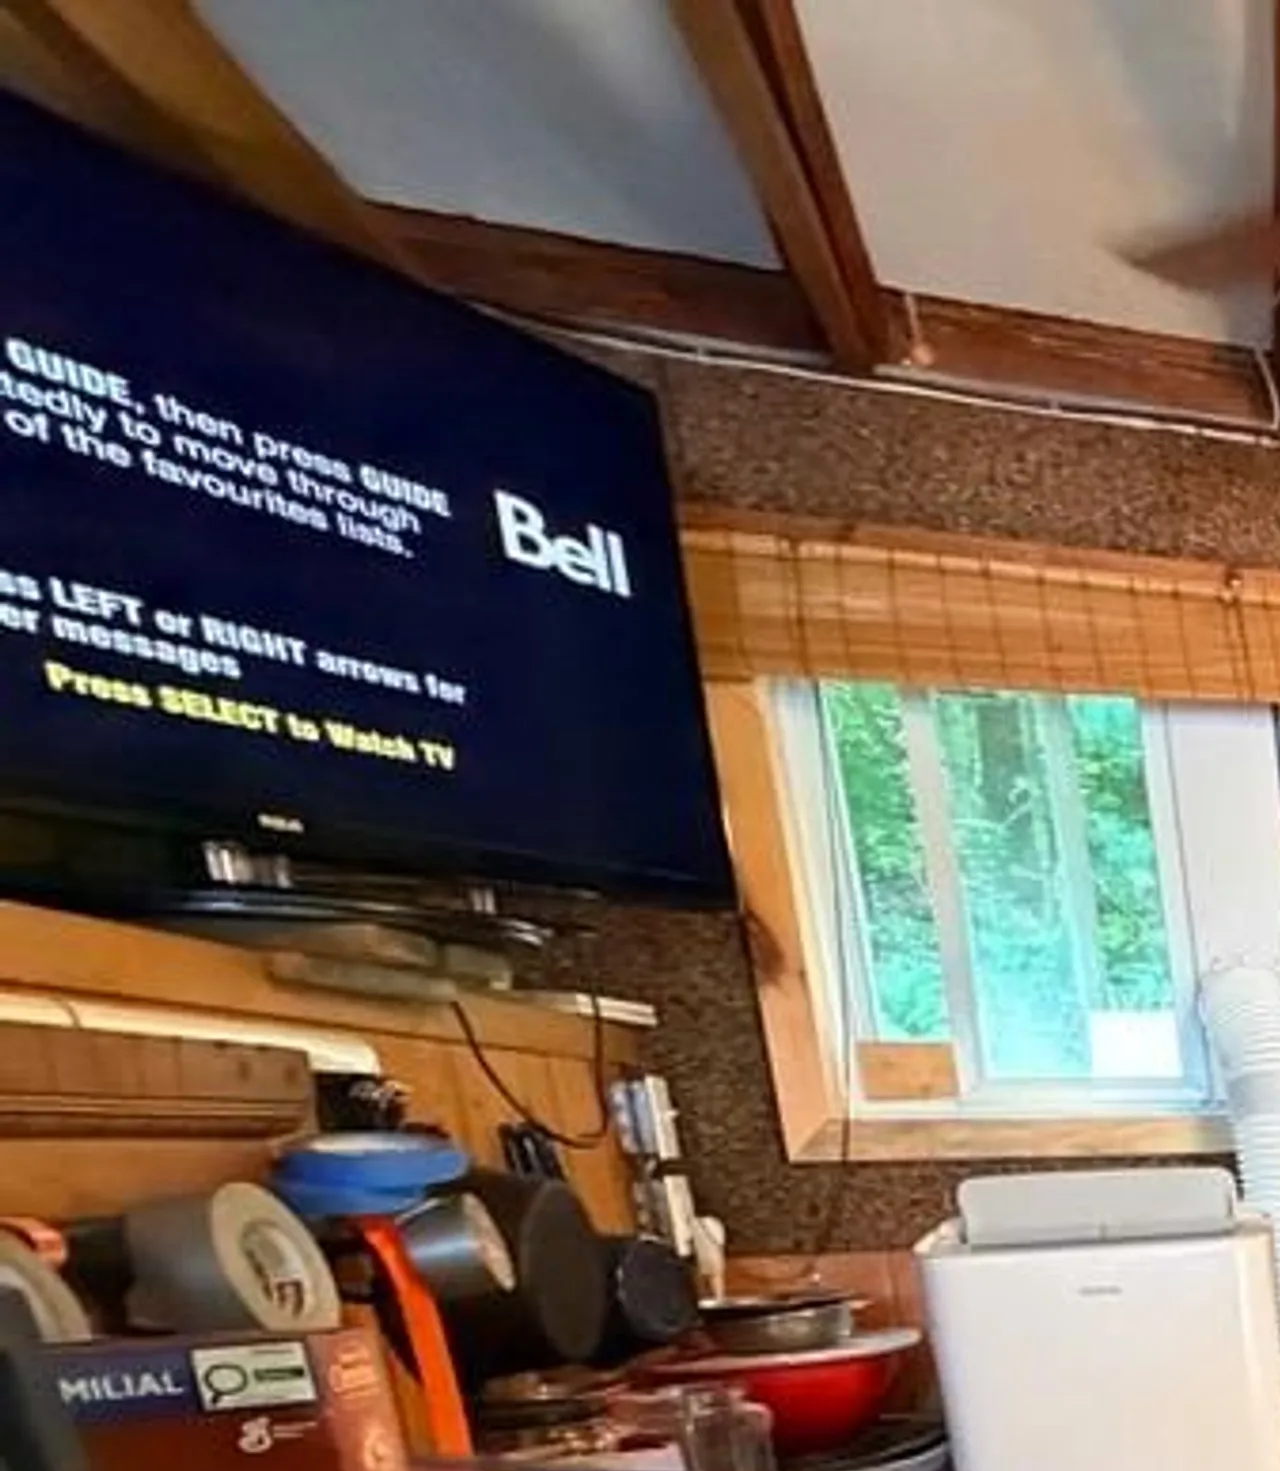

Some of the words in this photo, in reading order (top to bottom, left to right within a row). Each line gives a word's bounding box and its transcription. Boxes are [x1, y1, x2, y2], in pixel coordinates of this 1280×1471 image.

[4, 408, 49, 444] of
[61, 422, 132, 468] the
[141, 449, 328, 532] favourites
[335, 511, 414, 559] lists.
[6, 337, 145, 415] GUIDE,
[153, 394, 244, 446] then
[252, 431, 352, 484] press
[359, 463, 452, 519] GUIDE
[117, 410, 162, 446] to
[172, 434, 279, 487] move
[286, 467, 422, 535] through
[494, 488, 632, 598] Bell
[49, 575, 144, 627] LEFT
[153, 608, 193, 638] or
[200, 612, 307, 667] RIGHT
[315, 650, 420, 695] arrows
[424, 672, 466, 706] for
[51, 613, 242, 680] messages
[43, 659, 153, 709] Press
[158, 684, 280, 734] SELECT
[286, 712, 321, 741] to
[323, 718, 417, 763] Watch
[417, 739, 456, 771] TV
